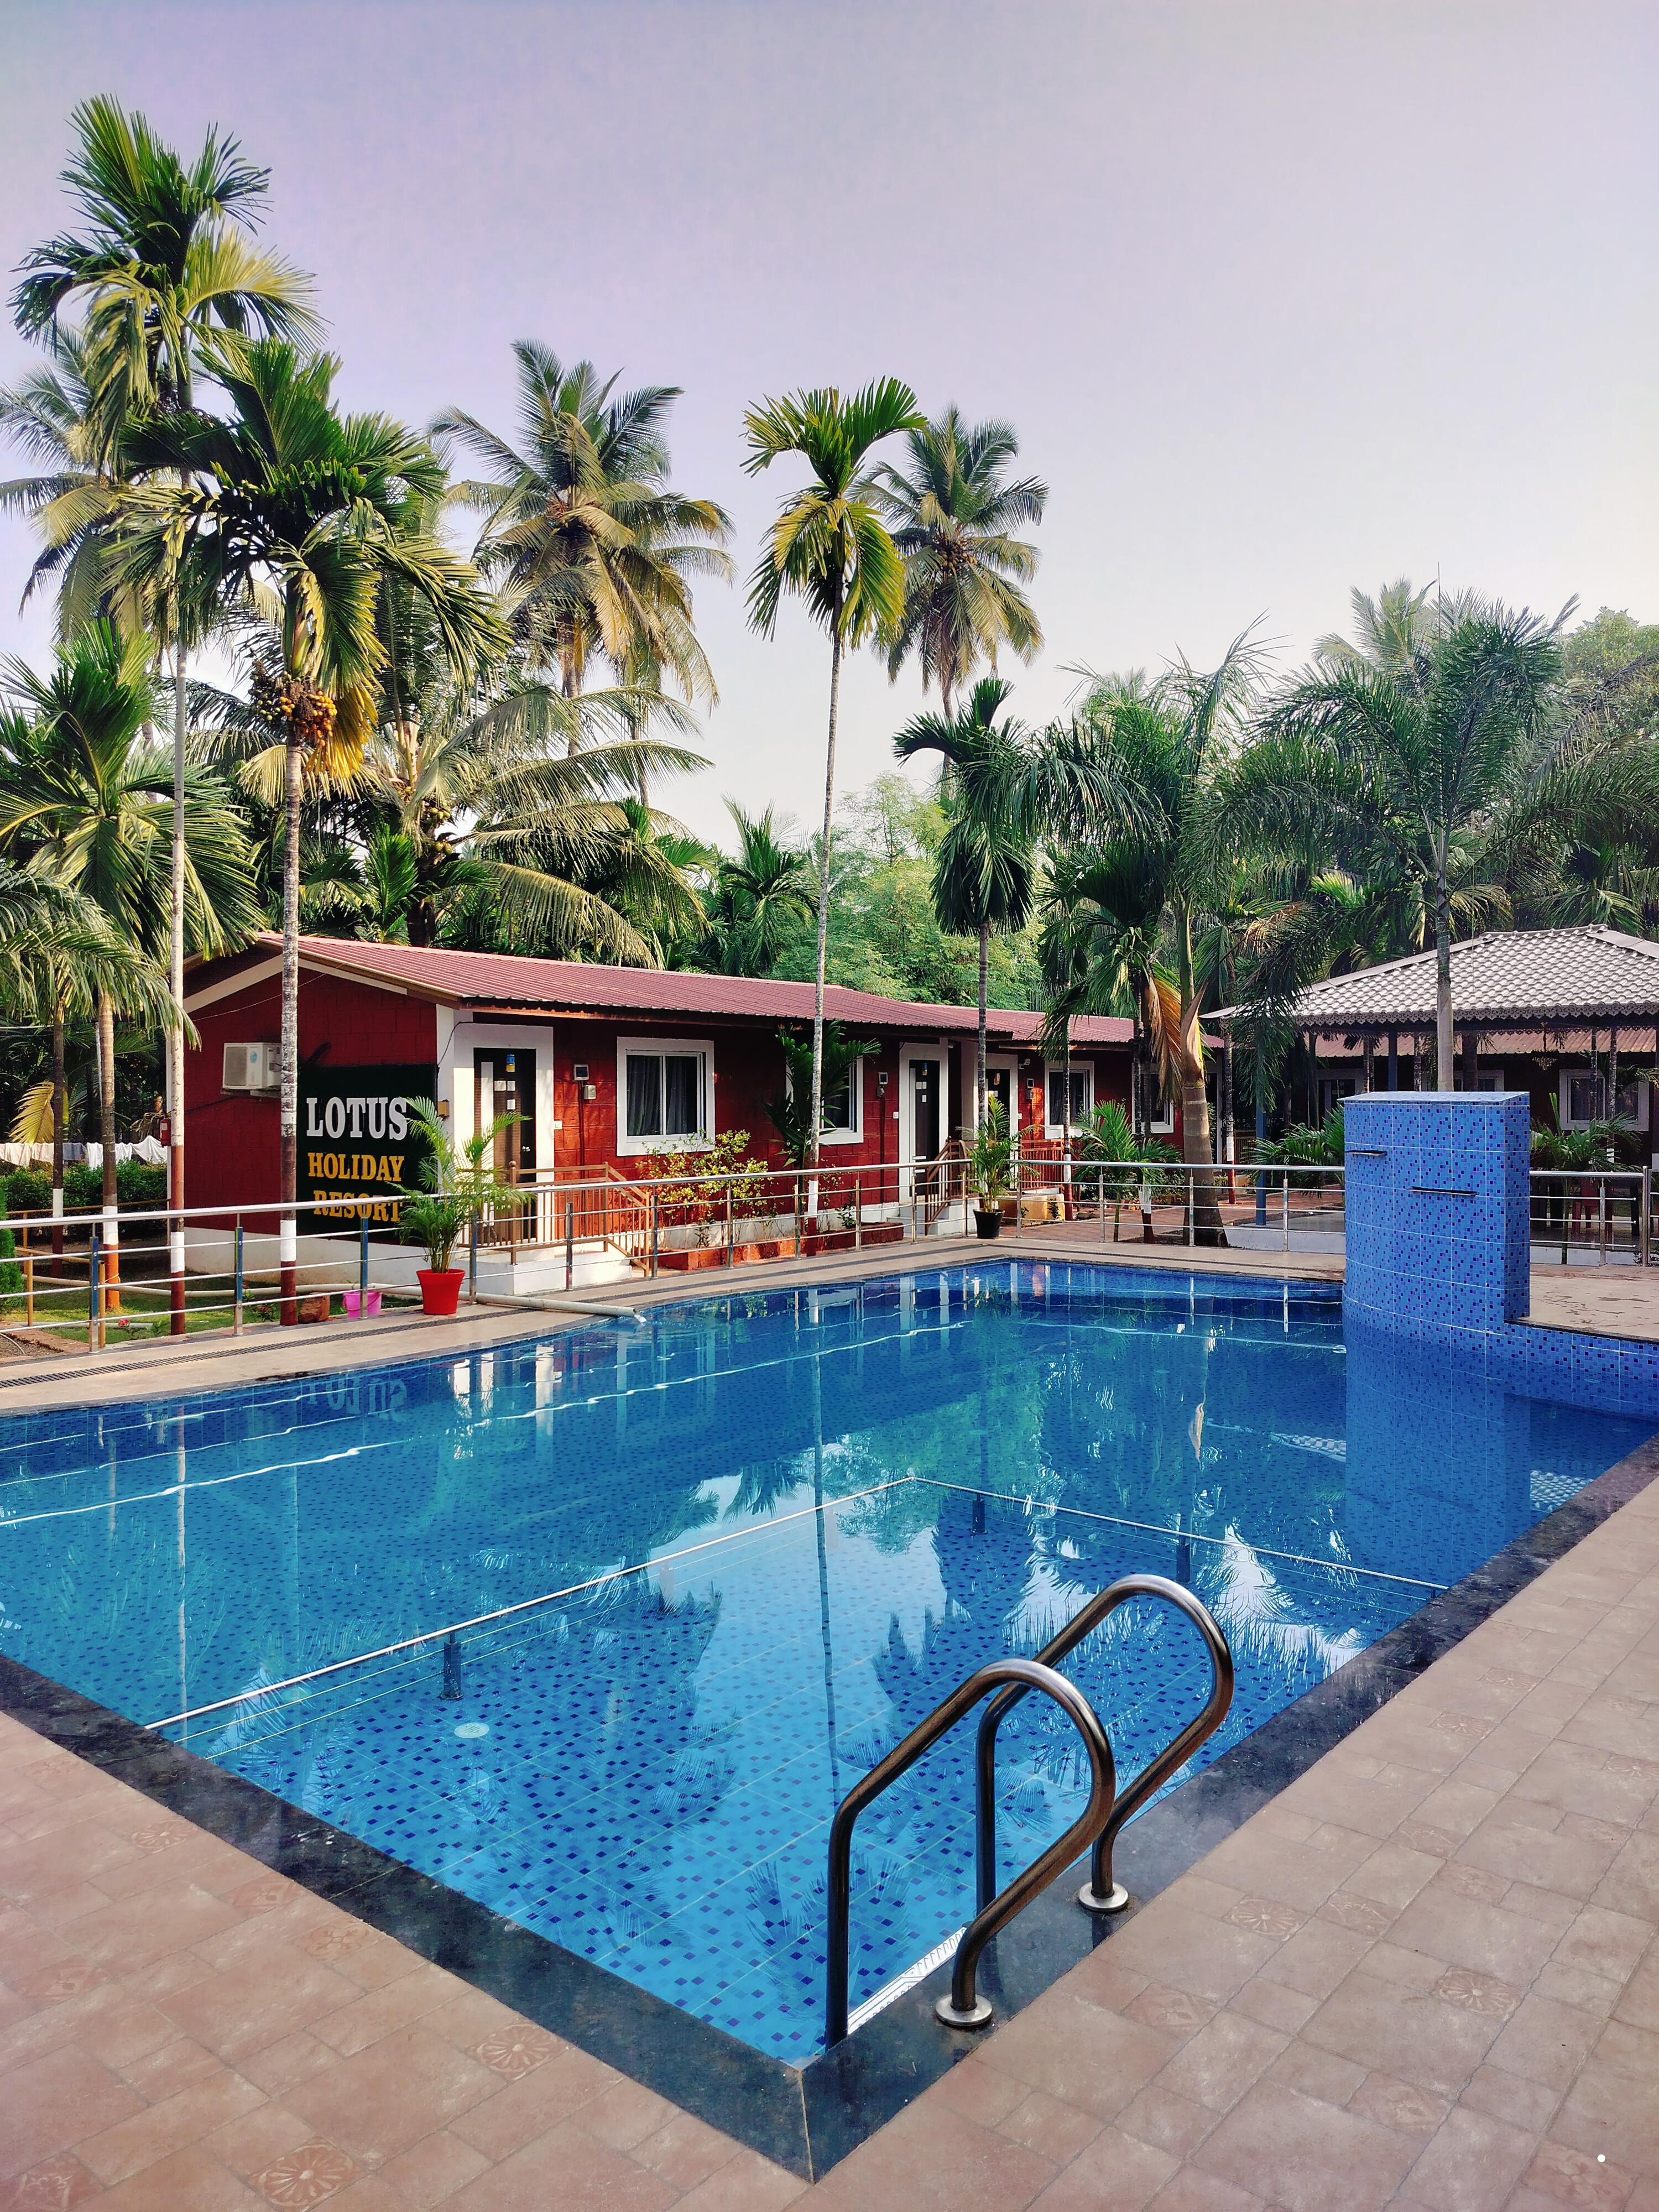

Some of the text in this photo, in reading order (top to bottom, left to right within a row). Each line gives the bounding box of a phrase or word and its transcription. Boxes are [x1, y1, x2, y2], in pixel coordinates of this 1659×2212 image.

[306, 1097, 408, 1140] LOTUS
[307, 1152, 404, 1182] HOLIDAY
[313, 1190, 403, 1222] RESORT
